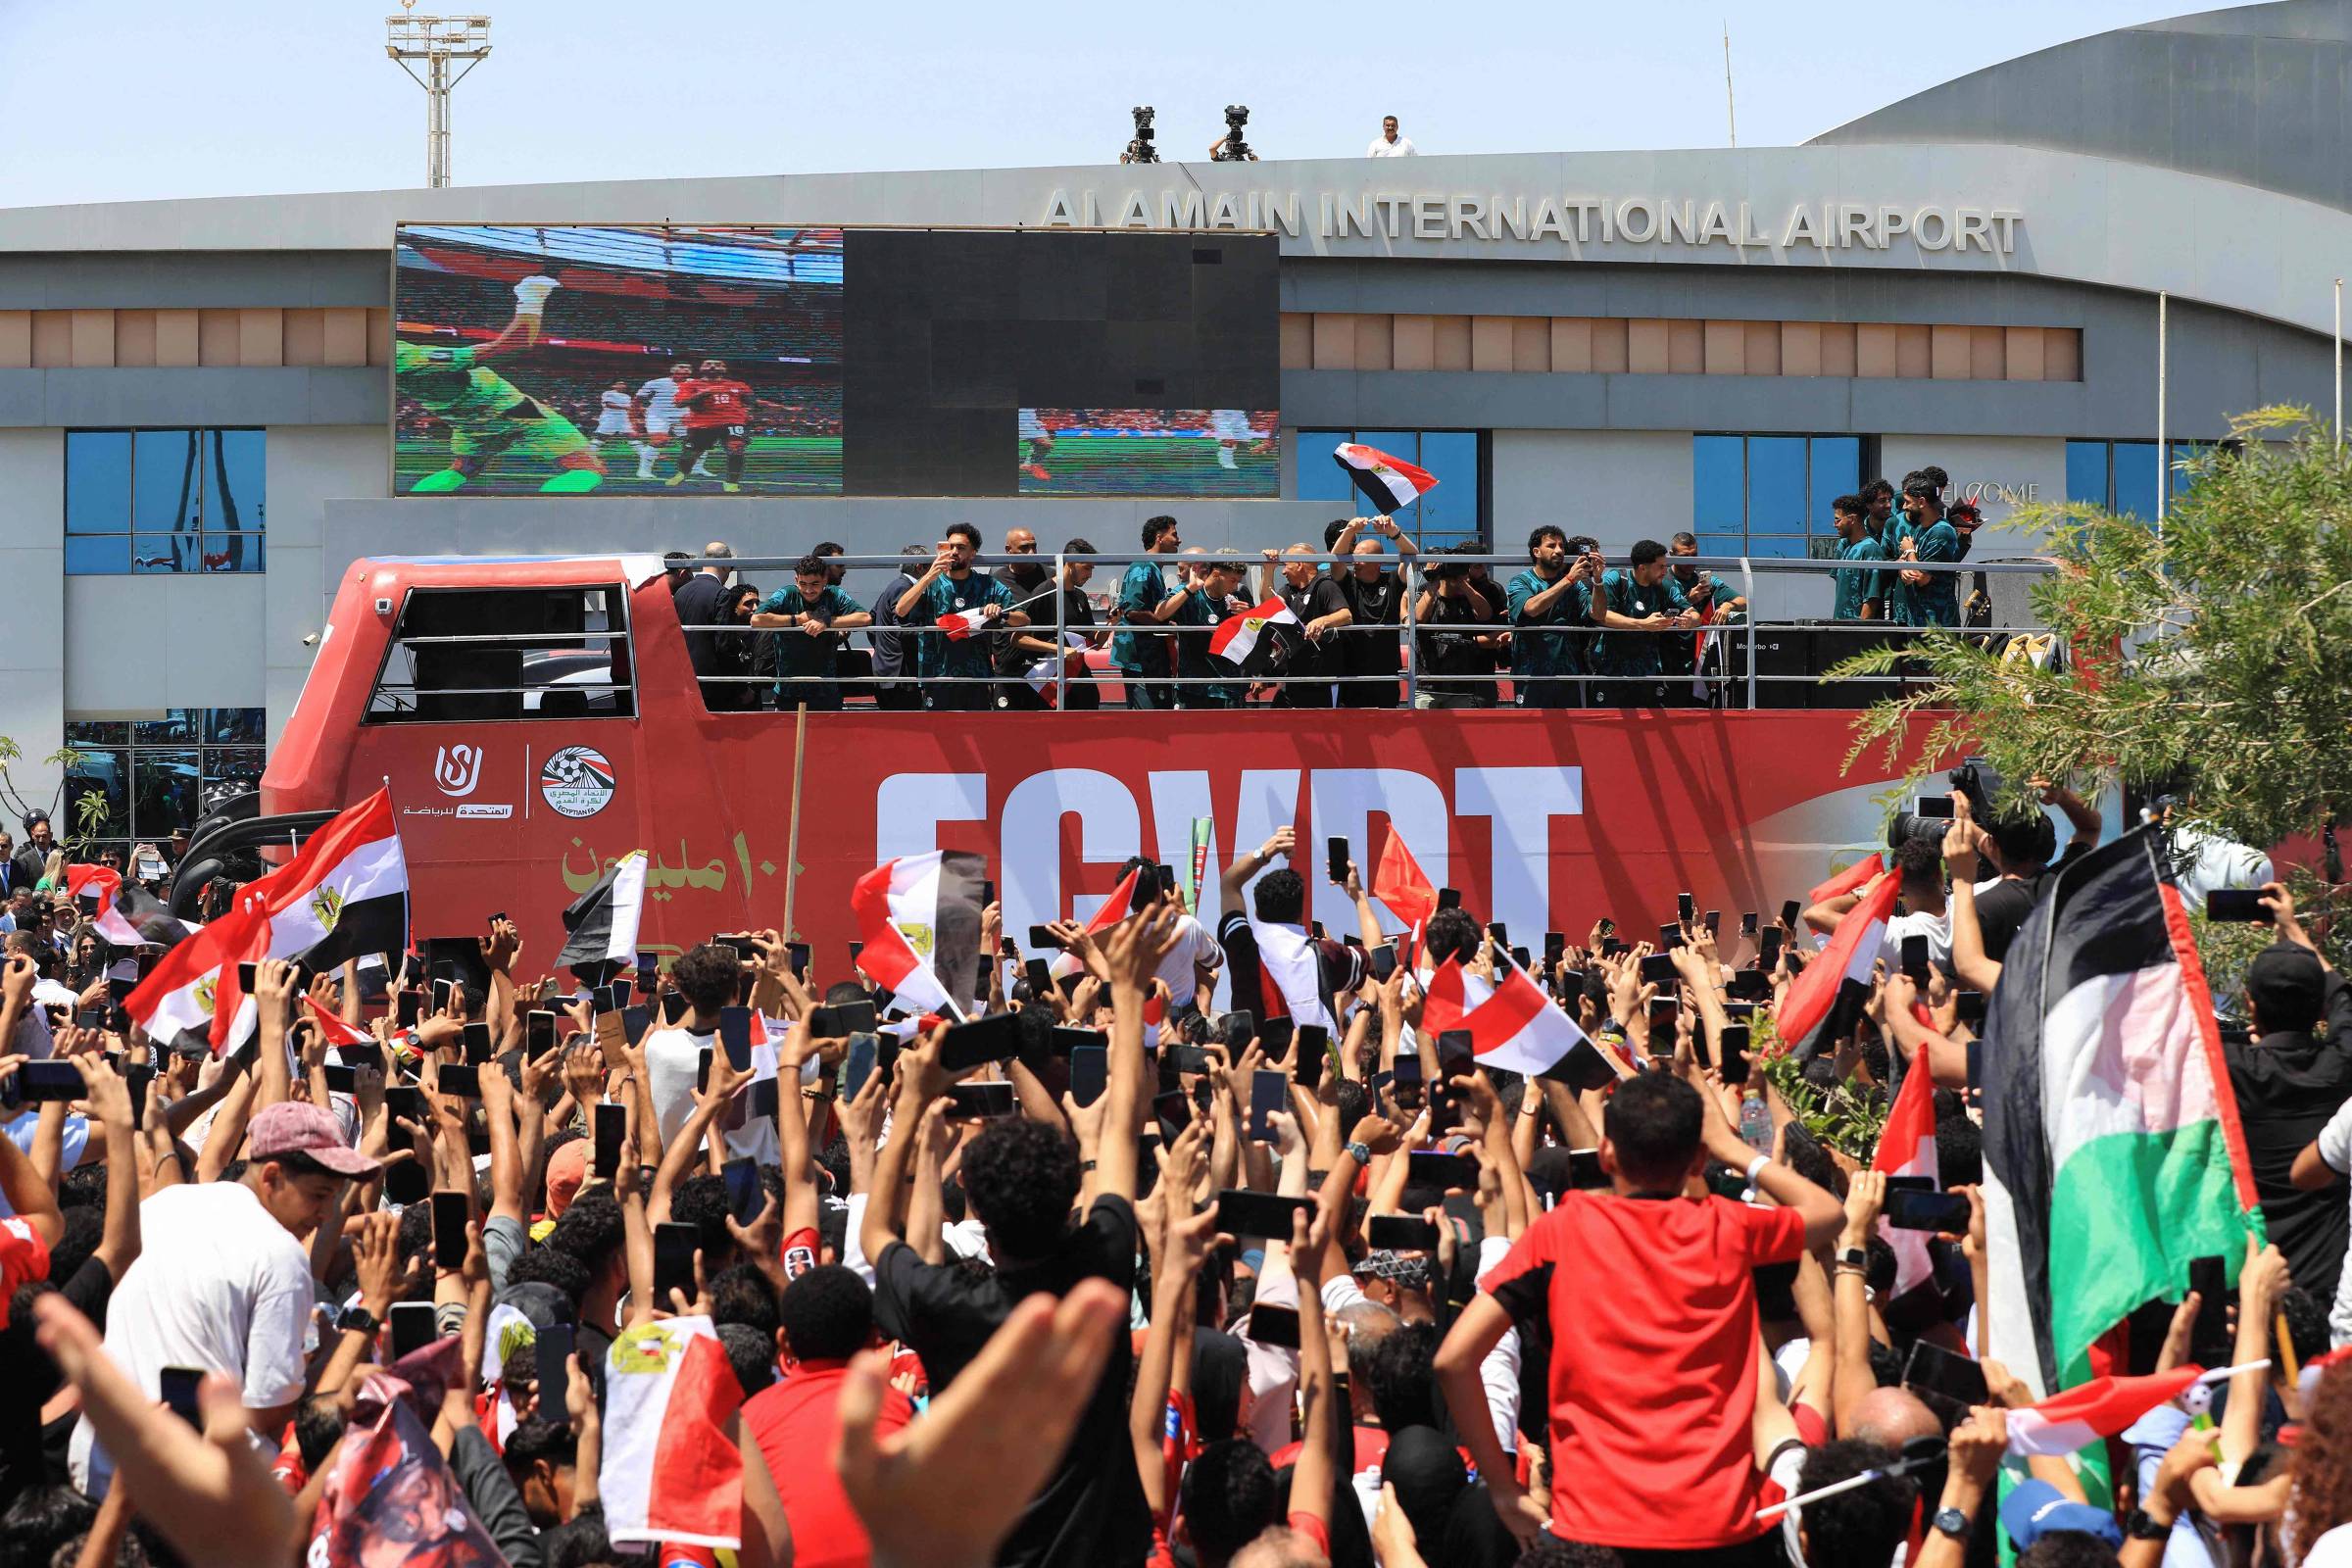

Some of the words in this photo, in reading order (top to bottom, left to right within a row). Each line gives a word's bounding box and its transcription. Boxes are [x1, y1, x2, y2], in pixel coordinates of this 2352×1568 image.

[1321, 194, 1770, 247] INTERNATIONAL
[1783, 204, 2024, 253] AIRPORT
[1941, 481, 2039, 504] ELCOME
[403, 805, 454, 818] للرياضة
[460, 806, 509, 816] المتحدة
[557, 804, 587, 816] EGYPTIAN
[588, 806, 596, 814] FA
